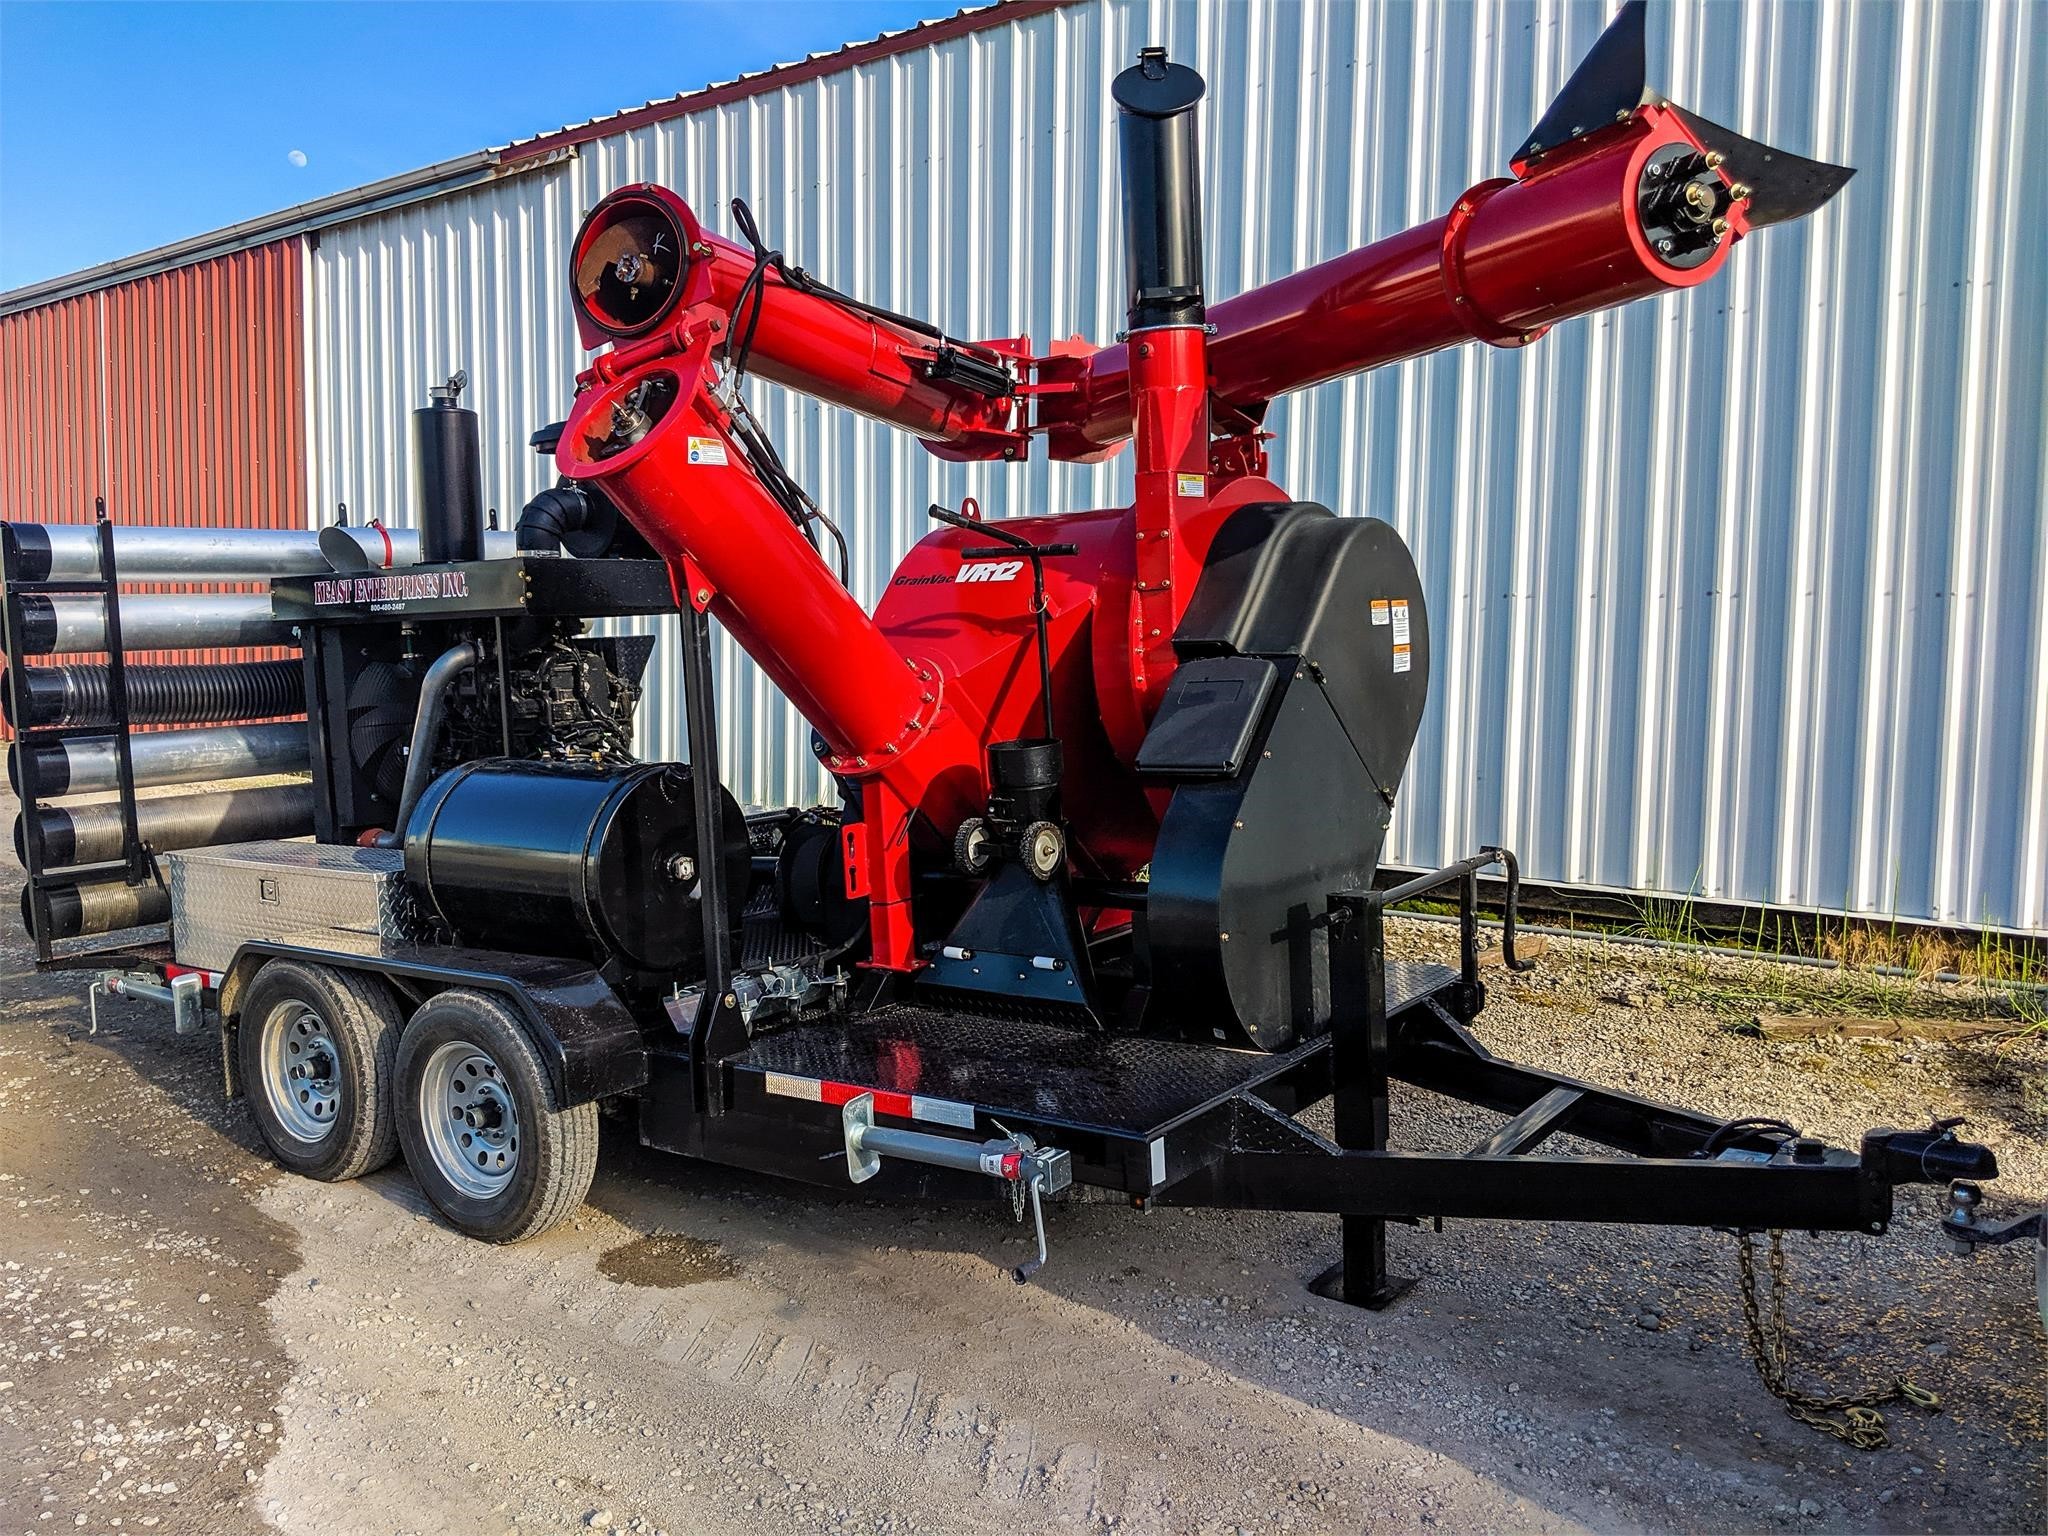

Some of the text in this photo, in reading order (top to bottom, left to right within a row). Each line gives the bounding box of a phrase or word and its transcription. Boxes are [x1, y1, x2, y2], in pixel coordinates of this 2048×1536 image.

[895, 561, 1024, 586] GrainVac VR12
[314, 572, 469, 605] KEAST ENTERPRISES INC.
